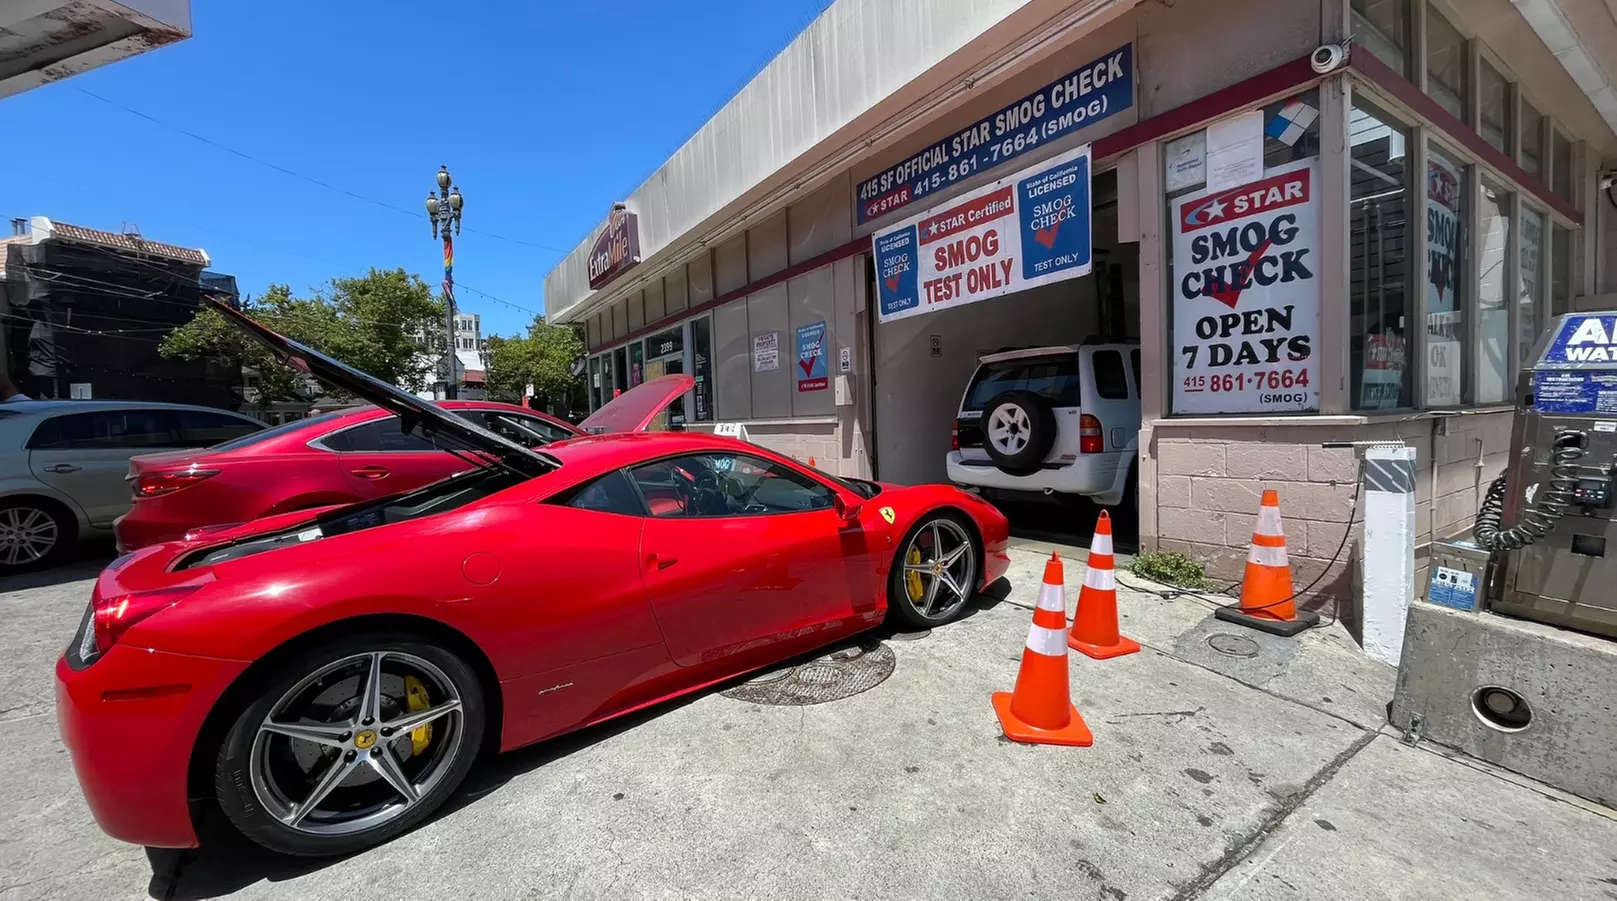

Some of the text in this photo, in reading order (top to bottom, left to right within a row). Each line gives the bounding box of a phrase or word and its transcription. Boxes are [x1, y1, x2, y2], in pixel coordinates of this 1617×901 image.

[860, 52, 1124, 200] 415 SF OFFICIAL STAR SMOG CHECK
[1041, 95, 1108, 139] (SMOG)
[1026, 180, 1041, 190] State
[1049, 165, 1078, 181] California
[1028, 174, 1077, 199] LICENSED
[880, 190, 908, 211] STAR
[1033, 194, 1073, 218] SMOG
[1234, 180, 1303, 214] STAR
[939, 196, 1012, 233] STAR Certified
[1030, 205, 1076, 231] CHECK
[934, 229, 999, 272] SMOG
[1191, 213, 1300, 264] SMOG
[883, 261, 910, 278] CHECK
[884, 253, 908, 268] SMOG
[1034, 252, 1079, 272] TEST ONLY
[1181, 248, 1314, 300] CHECK
[923, 258, 1014, 304] TEST ONLY
[1195, 305, 1295, 340] OPEN
[1182, 335, 1312, 369] 7 DAYS
[1183, 375, 1205, 388] 415
[1259, 391, 1308, 405] (SMOG)
